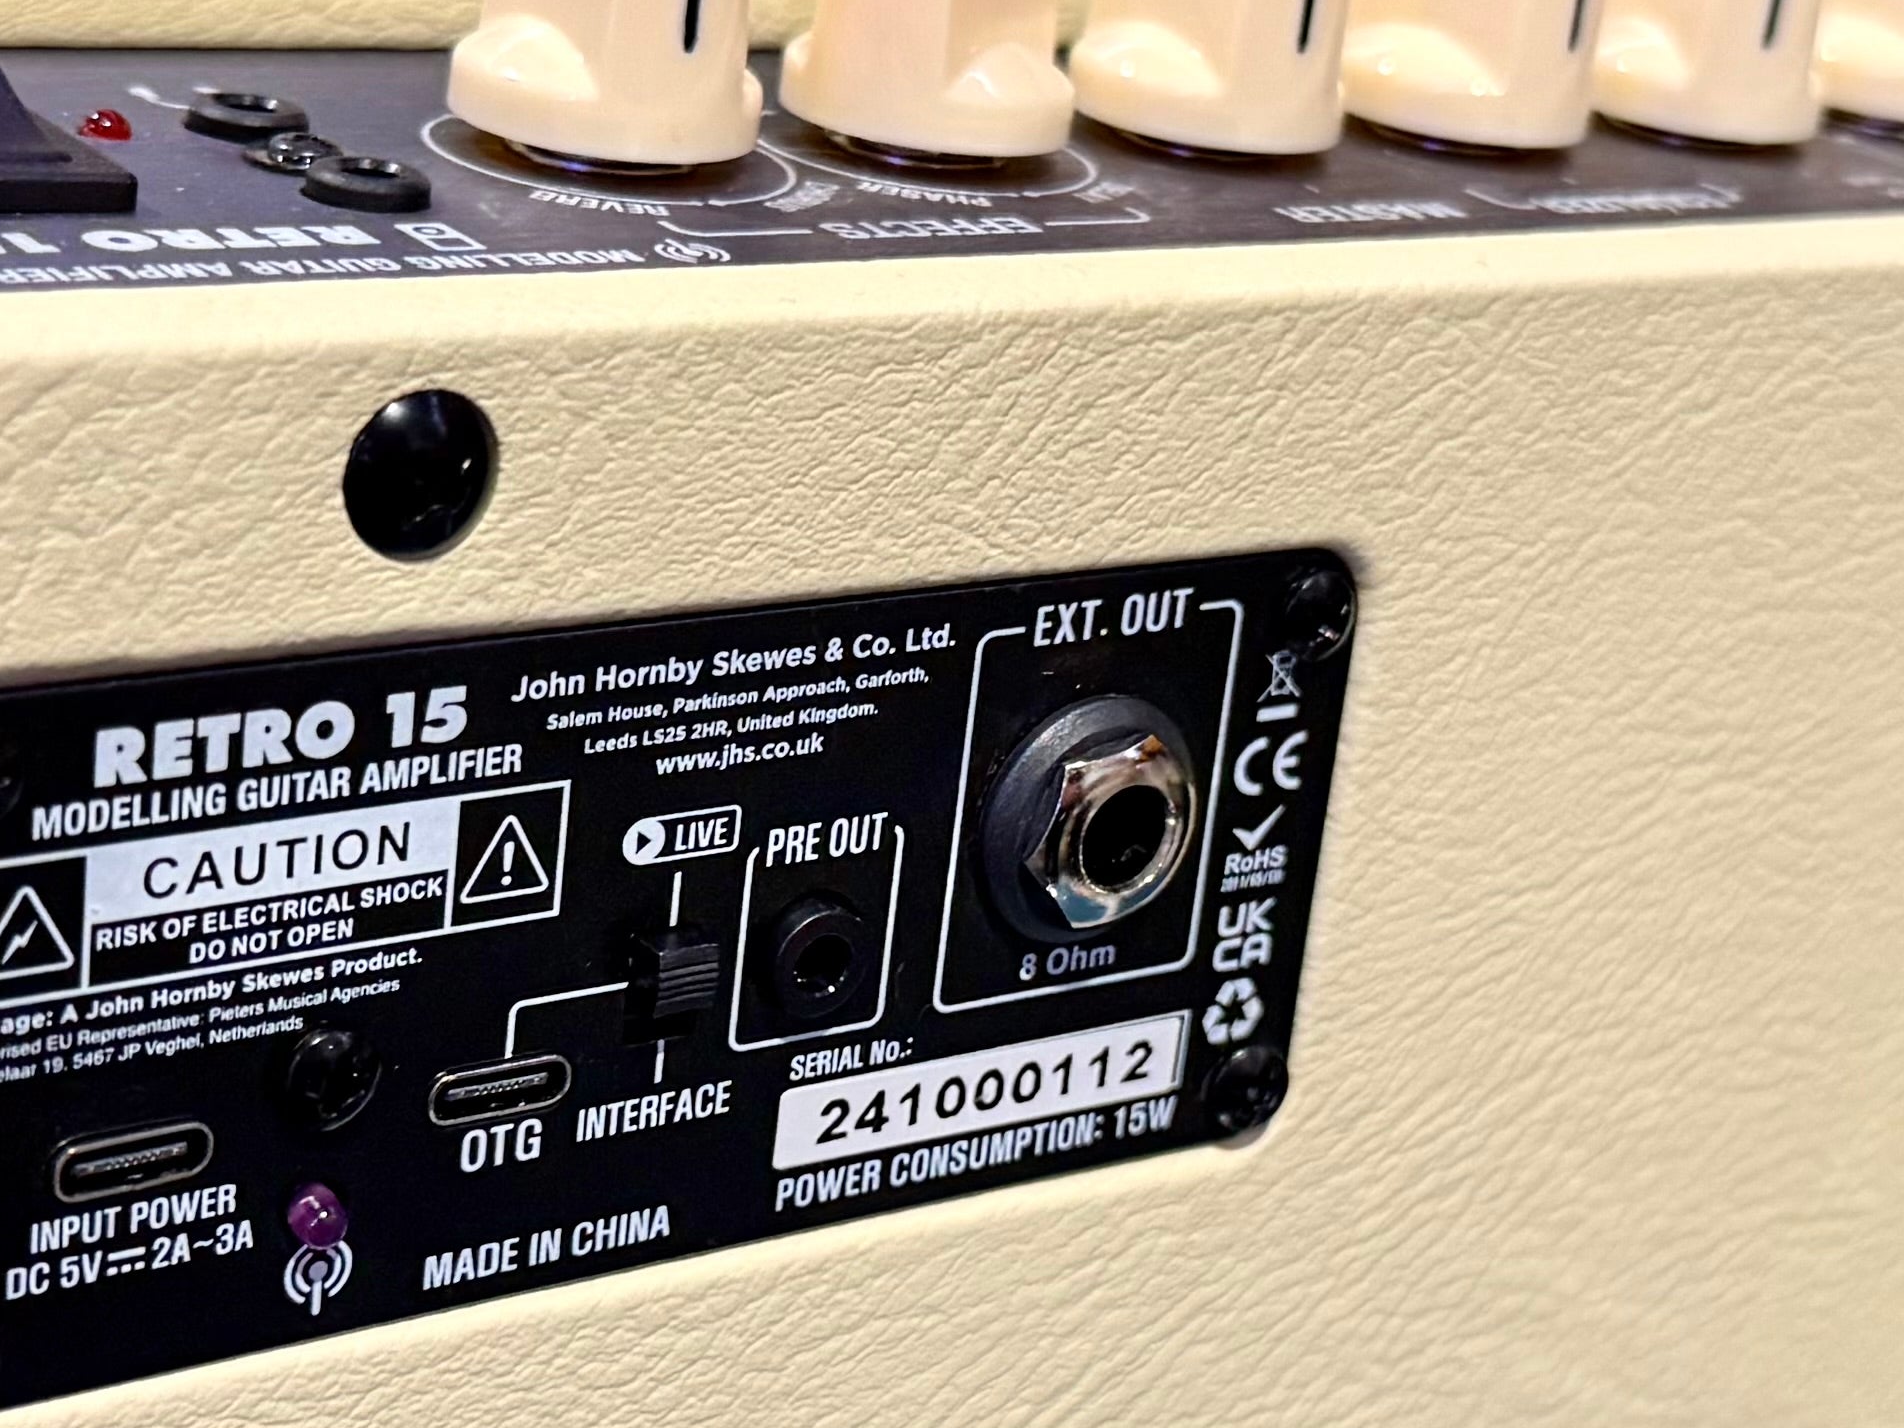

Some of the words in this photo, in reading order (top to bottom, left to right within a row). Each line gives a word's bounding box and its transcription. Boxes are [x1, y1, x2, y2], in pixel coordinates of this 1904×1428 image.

[528, 189, 670, 217] REVERB
[857, 181, 992, 208] PHASER
[1273, 201, 1469, 224] MASTER
[81, 224, 381, 251] RETRO
[820, 217, 1043, 240] EFFECTS
[238, 257, 402, 275] GUITAR
[406, 248, 647, 271] MODELLING
[1034, 599, 1108, 647] EXT.
[1120, 587, 1194, 636] OUT
[511, 671, 585, 702] John
[595, 657, 704, 692] Hornby
[712, 641, 816, 677] Skewes
[827, 642, 843, 662] &
[852, 632, 896, 656] Co.
[905, 623, 956, 652] Ltd.
[546, 709, 603, 731] Salem
[608, 701, 669, 723] House,
[673, 689, 758, 715] Parkinson
[763, 677, 850, 707] Approach,
[856, 665, 930, 689] Garforth,
[93, 699, 355, 788] RETRO
[386, 684, 467, 748] 15
[584, 733, 638, 755] Leeds
[642, 725, 687, 747] LS25
[691, 719, 733, 741] 2HR,
[737, 710, 793, 734] United
[799, 700, 878, 726] Kingdom.
[656, 732, 824, 775] www.jhs.co.uk
[32, 780, 226, 841] MODELLING
[236, 767, 350, 812] GUITAR
[360, 743, 523, 794] AMPLIFIER
[143, 821, 411, 899] CAUTION
[674, 816, 729, 852] LIVE
[766, 821, 822, 867] PRE
[829, 812, 888, 858] OUT
[1224, 845, 1288, 875] RoHS
[96, 921, 159, 952] RISK
[162, 914, 195, 939] OF
[202, 892, 355, 934] ELECTRICAL
[360, 875, 443, 909] SHOCK
[189, 940, 227, 964] DO
[232, 929, 281, 957] NOT
[287, 917, 354, 948] OPEN
[1218, 897, 1278, 938] UK
[1019, 953, 1037, 981] 8
[1047, 945, 1116, 975] Ohm
[1212, 933, 1273, 972] CA
[60, 1004, 78, 1024] A
[86, 993, 144, 1020] John
[151, 978, 236, 1010] Hornby
[242, 963, 324, 994] Skewes
[331, 946, 423, 977] Product.
[46, 1032, 74, 1052] EU
[209, 1000, 264, 1024] Pieters
[268, 989, 327, 1014] Musical
[330, 976, 401, 1005] Agencies
[73, 1046, 114, 1069] 5467
[117, 1042, 142, 1063] JP
[209, 1014, 304, 1046] Netherlands
[789, 1048, 863, 1081] SERIAL
[576, 1081, 732, 1143] INTERFACE
[816, 1039, 1154, 1146] 241000112
[459, 1119, 542, 1174] OTG
[774, 1158, 882, 1212] POWER
[890, 1108, 1105, 1186] CONSUMPTION:
[1113, 1095, 1179, 1139] 15W
[30, 1207, 121, 1255] INPUT
[129, 1184, 237, 1233] POWER
[423, 1234, 519, 1291] MADE
[529, 1227, 564, 1269] IN
[570, 1205, 672, 1257] CHINA
[5, 1260, 50, 1301] DC
